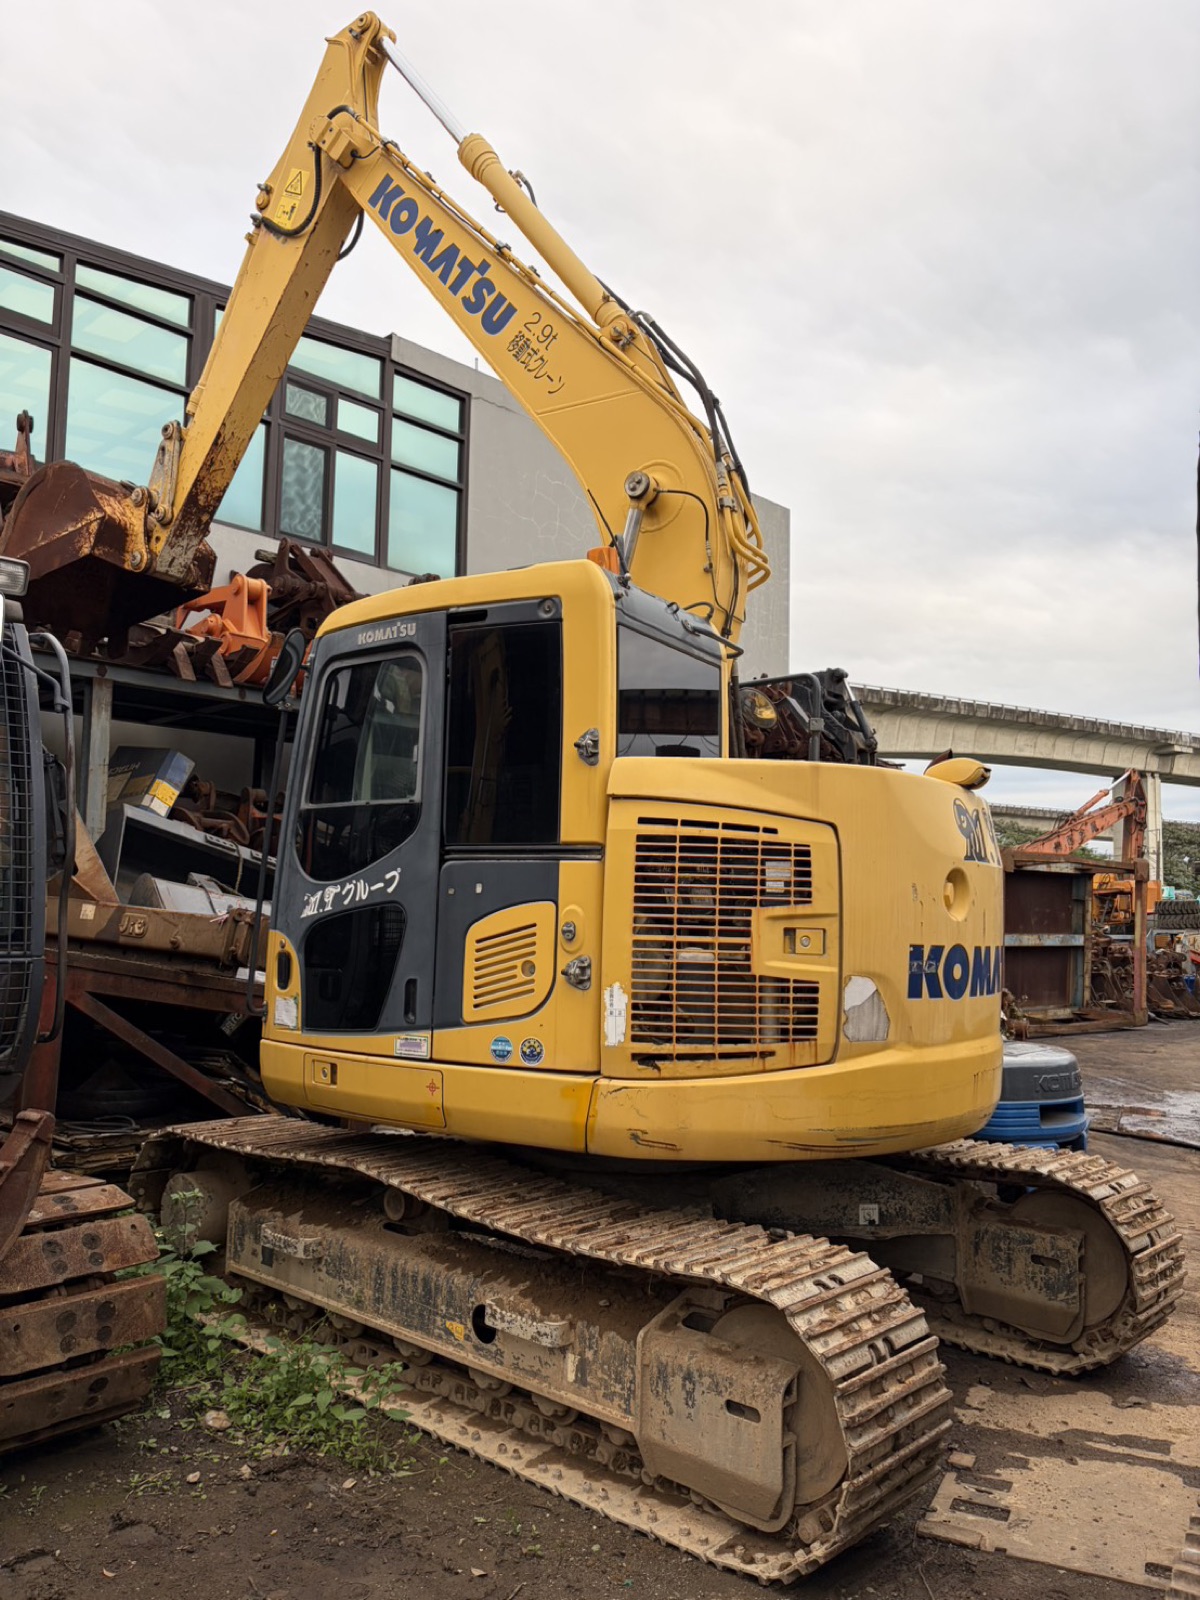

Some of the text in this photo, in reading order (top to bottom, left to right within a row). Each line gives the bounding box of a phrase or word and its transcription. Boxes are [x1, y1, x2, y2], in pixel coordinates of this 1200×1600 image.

[367, 172, 518, 336] KOMATSU
[523, 311, 559, 351] 2.9t
[357, 621, 417, 645] KOMATSU
